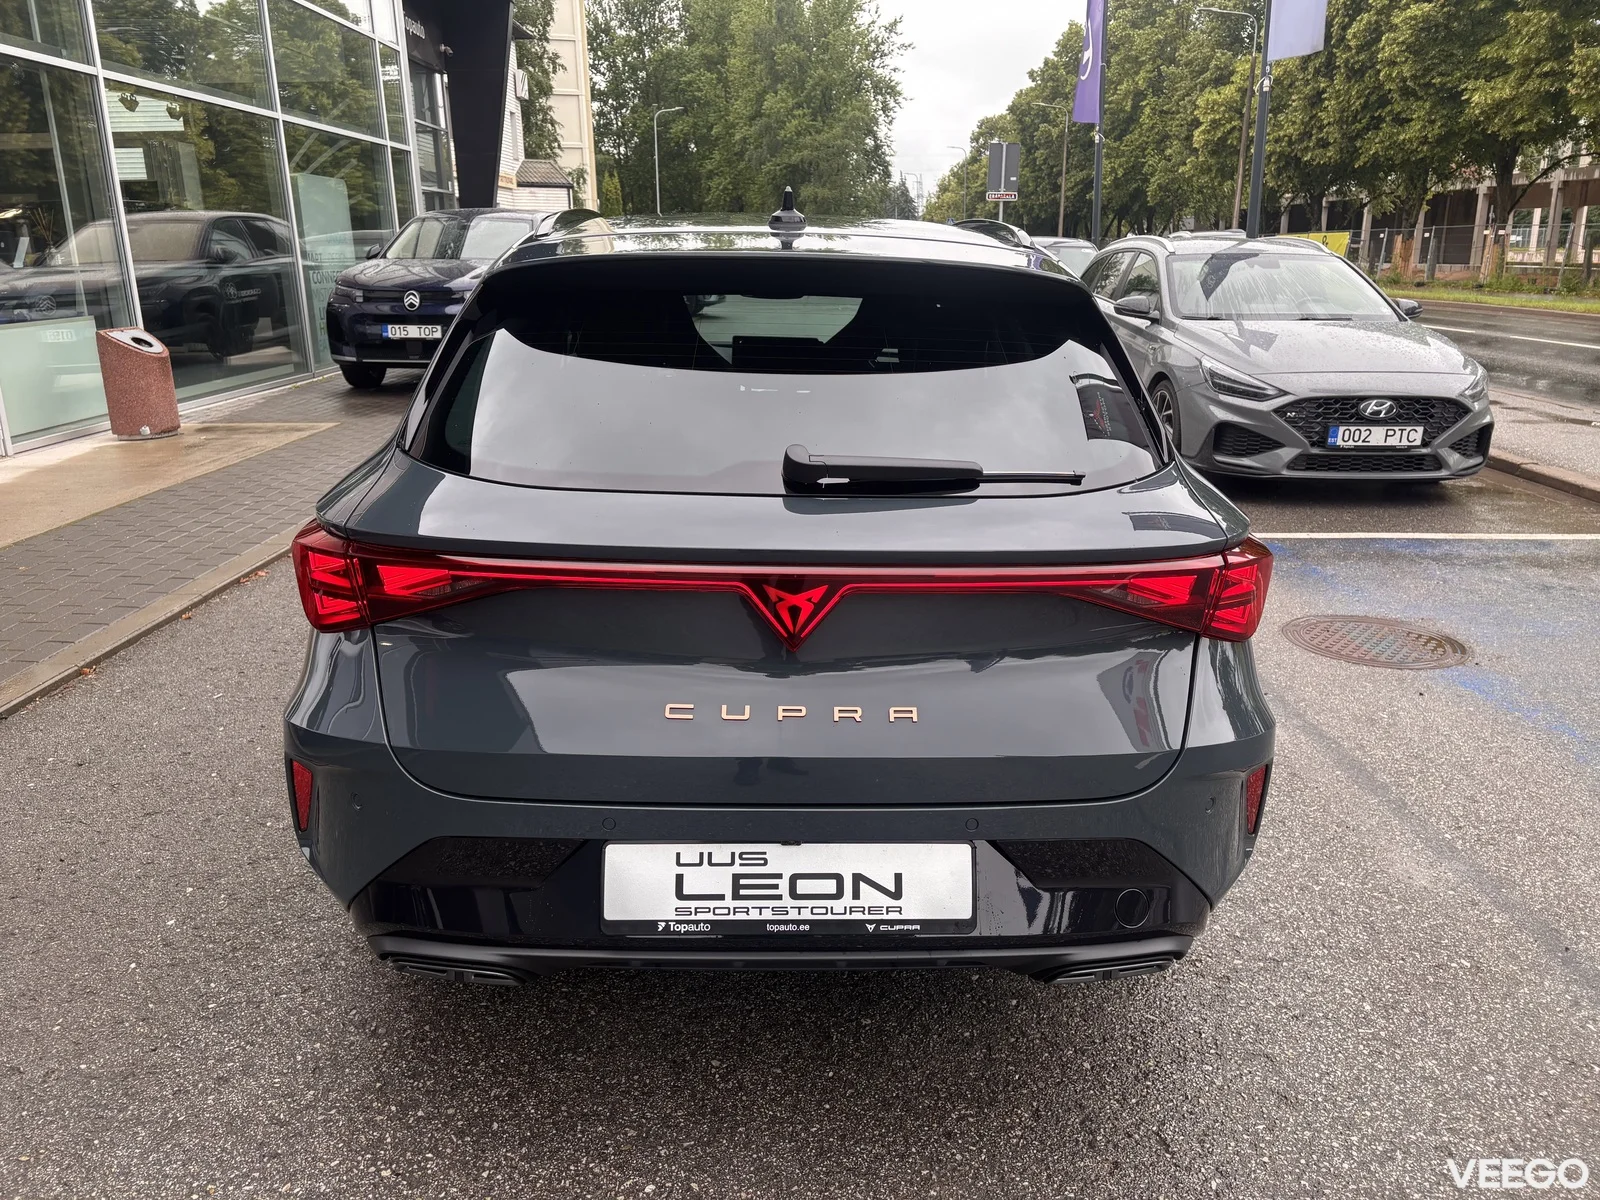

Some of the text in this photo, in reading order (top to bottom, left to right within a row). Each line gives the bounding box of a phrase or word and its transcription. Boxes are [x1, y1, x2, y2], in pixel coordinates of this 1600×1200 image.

[404, 13, 425, 39] opauto
[390, 326, 439, 337] 015 TOP
[1341, 428, 1419, 444] 002 PTC
[664, 703, 918, 723] CUPRA
[675, 851, 769, 868] UUS
[674, 872, 903, 902] LEON
[674, 905, 903, 917] SPORTSTOURER
[668, 921, 712, 934] Topauto
[766, 922, 811, 933] topauto.ee
